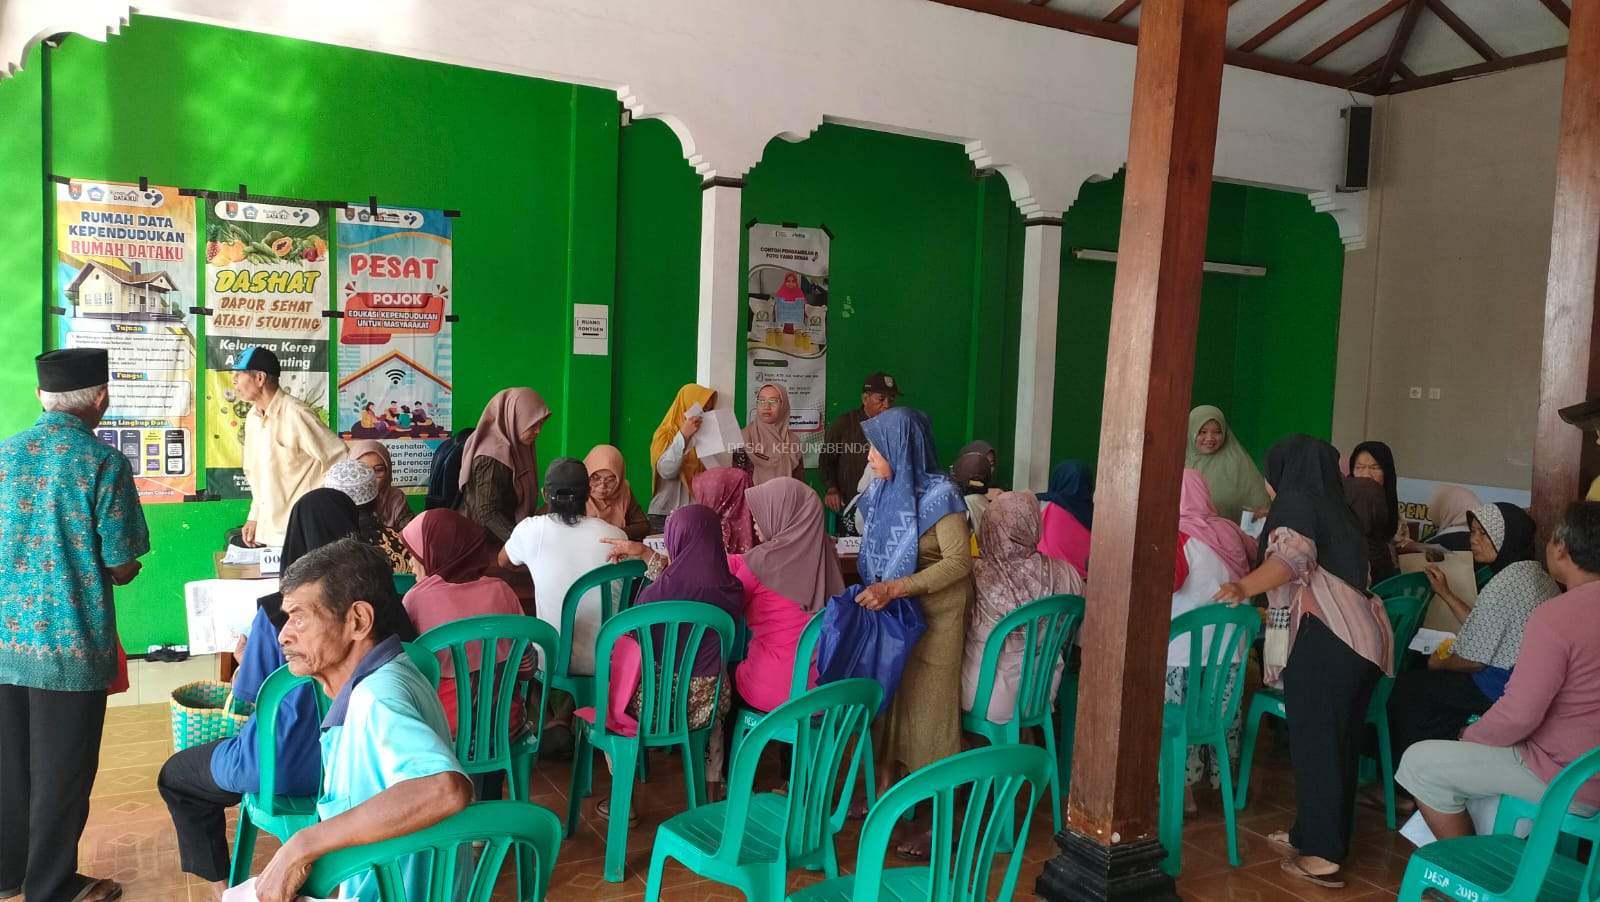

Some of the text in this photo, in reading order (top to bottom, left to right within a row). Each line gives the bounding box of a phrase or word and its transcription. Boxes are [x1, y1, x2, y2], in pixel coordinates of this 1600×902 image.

[81, 211, 173, 228] RUMAH DATA
[69, 225, 185, 243] KEPENDUDUKAN
[71, 241, 184, 260] RUMAH DATAKU
[350, 254, 439, 280] PESAT
[215, 270, 321, 293] DASHAT
[221, 297, 313, 313] DAPUR SEHAT
[373, 294, 423, 305] POJOK
[213, 314, 322, 331] ATASI STUNTING
[348, 310, 438, 320] EDUKASI KEPENDUDUKAN
[383, 321, 430, 329] MASYARAKAT
[281, 341, 316, 353] Keren
[280, 357, 311, 369] nting
[1424, 868, 1479, 902] DESA 2019
